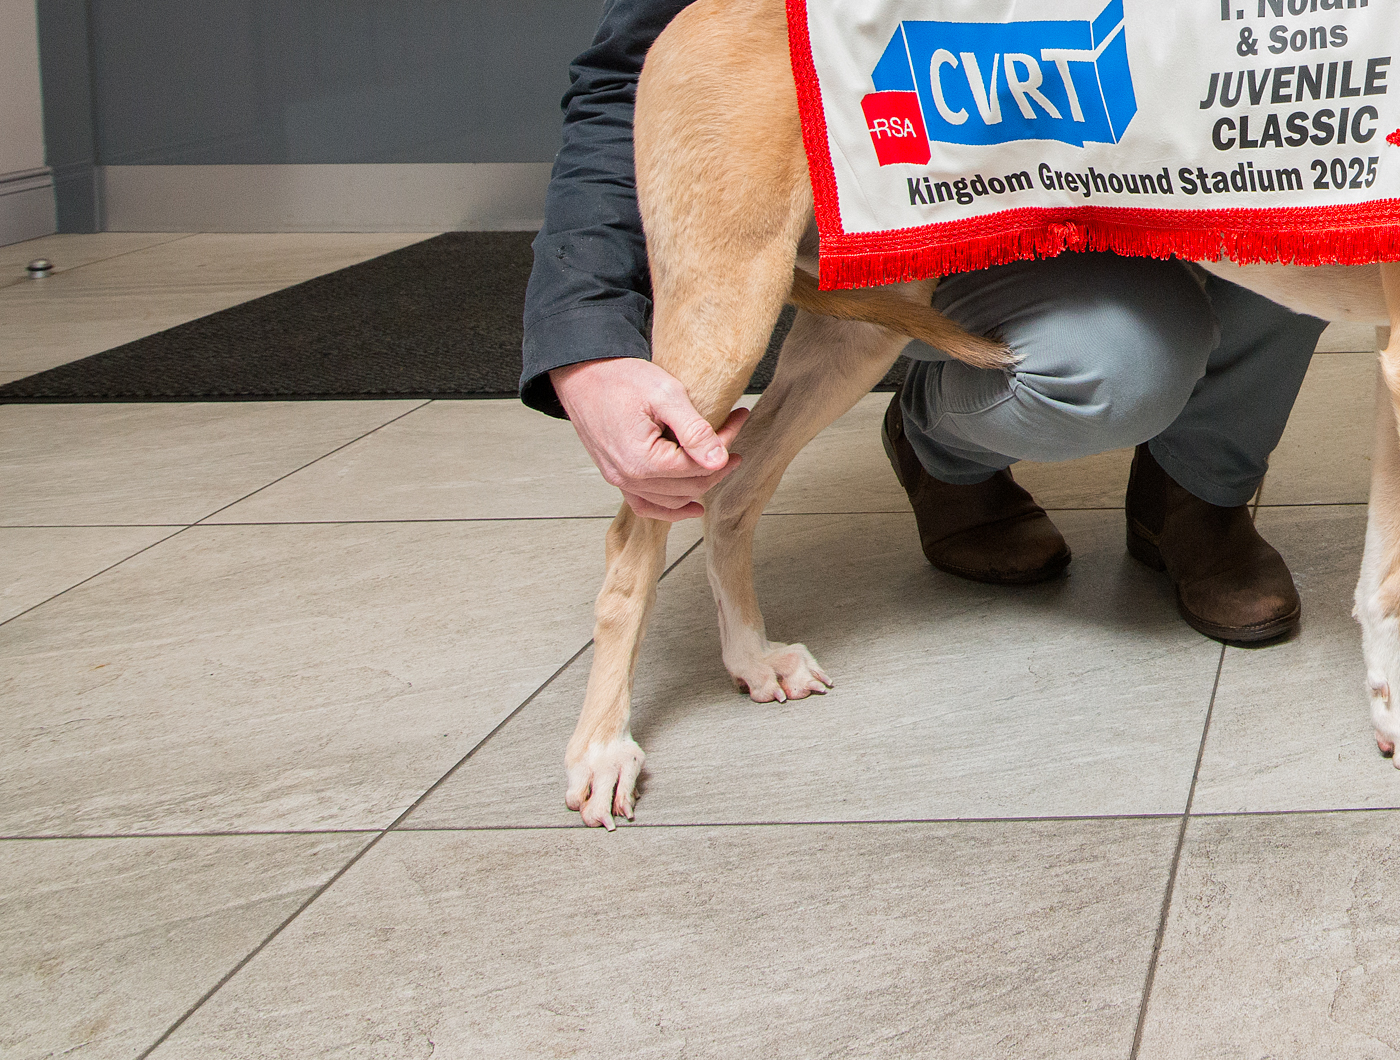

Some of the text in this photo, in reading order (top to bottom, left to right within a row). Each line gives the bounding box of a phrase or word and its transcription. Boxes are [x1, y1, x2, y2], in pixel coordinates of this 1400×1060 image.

[1236, 24, 1349, 57] & Sons
[929, 48, 1095, 126] CVRT
[1199, 56, 1392, 110] JUVENILE
[1211, 105, 1380, 151] CLASSIC
[906, 156, 1380, 206] Kingdom Greyhound Stadium 2025
